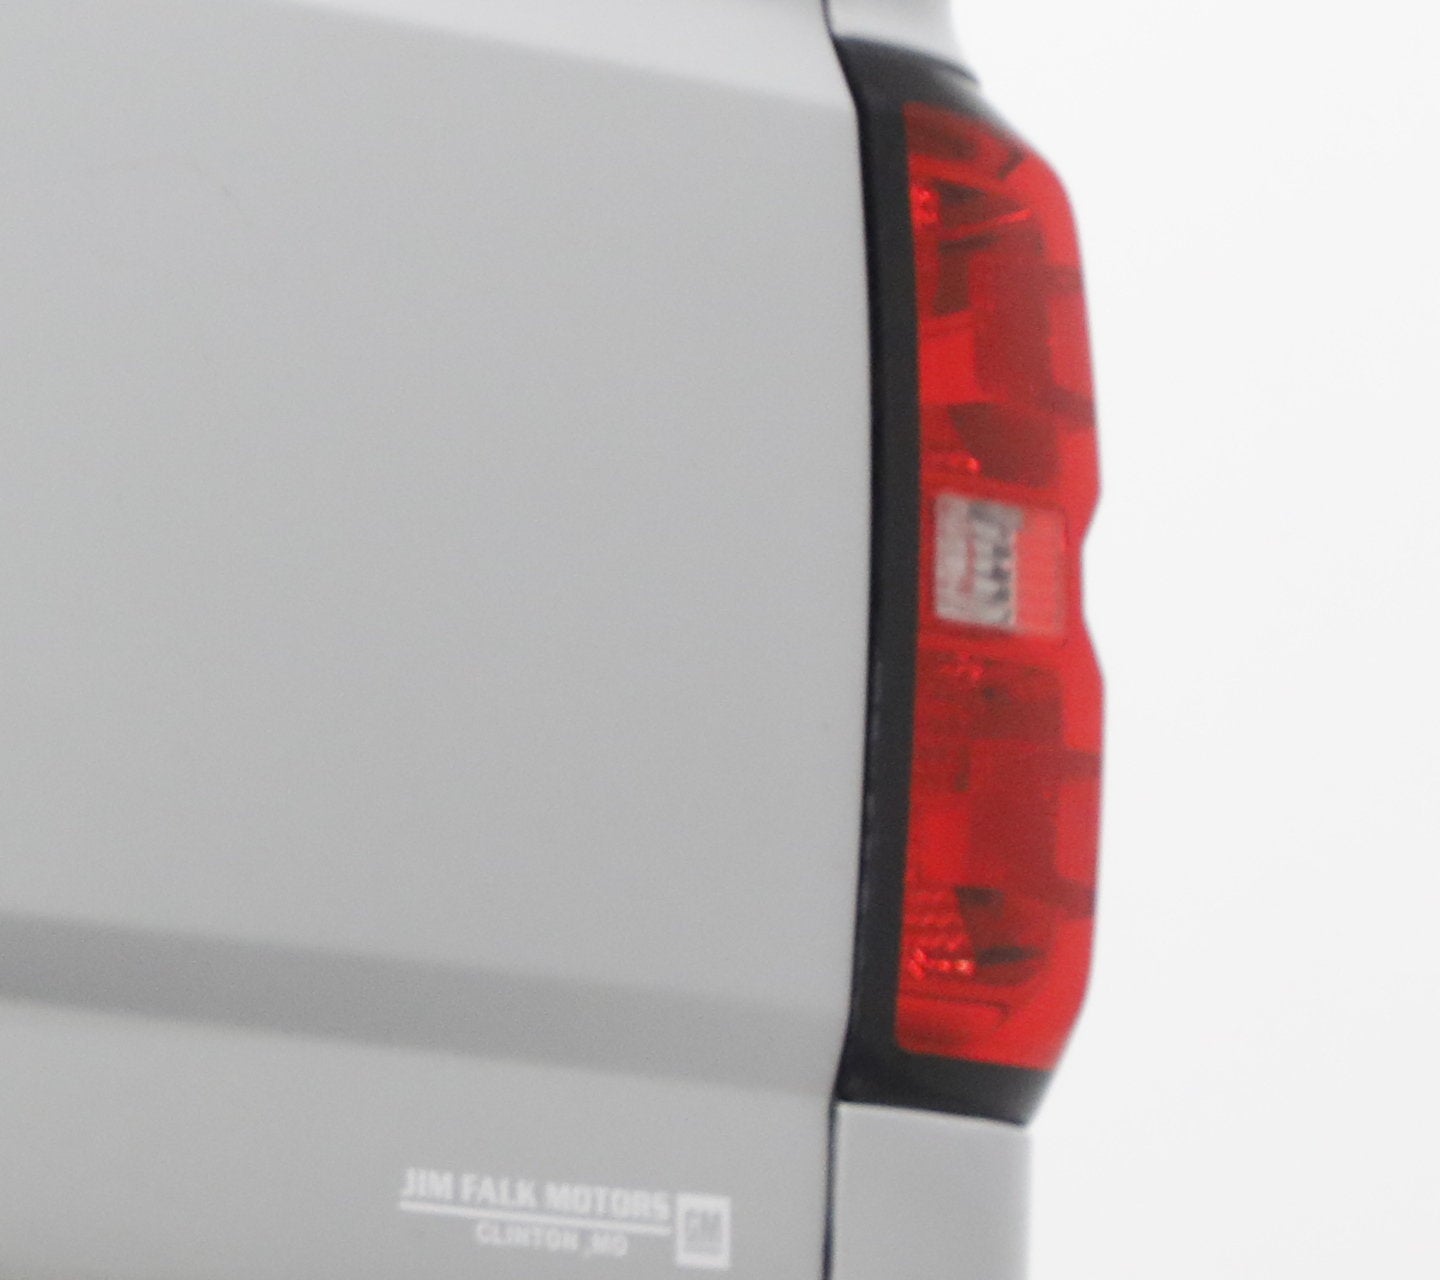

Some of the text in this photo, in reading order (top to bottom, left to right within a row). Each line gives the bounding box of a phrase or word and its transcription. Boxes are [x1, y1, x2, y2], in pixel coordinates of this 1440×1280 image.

[400, 1167, 670, 1220] JIM FALK MOTORS
